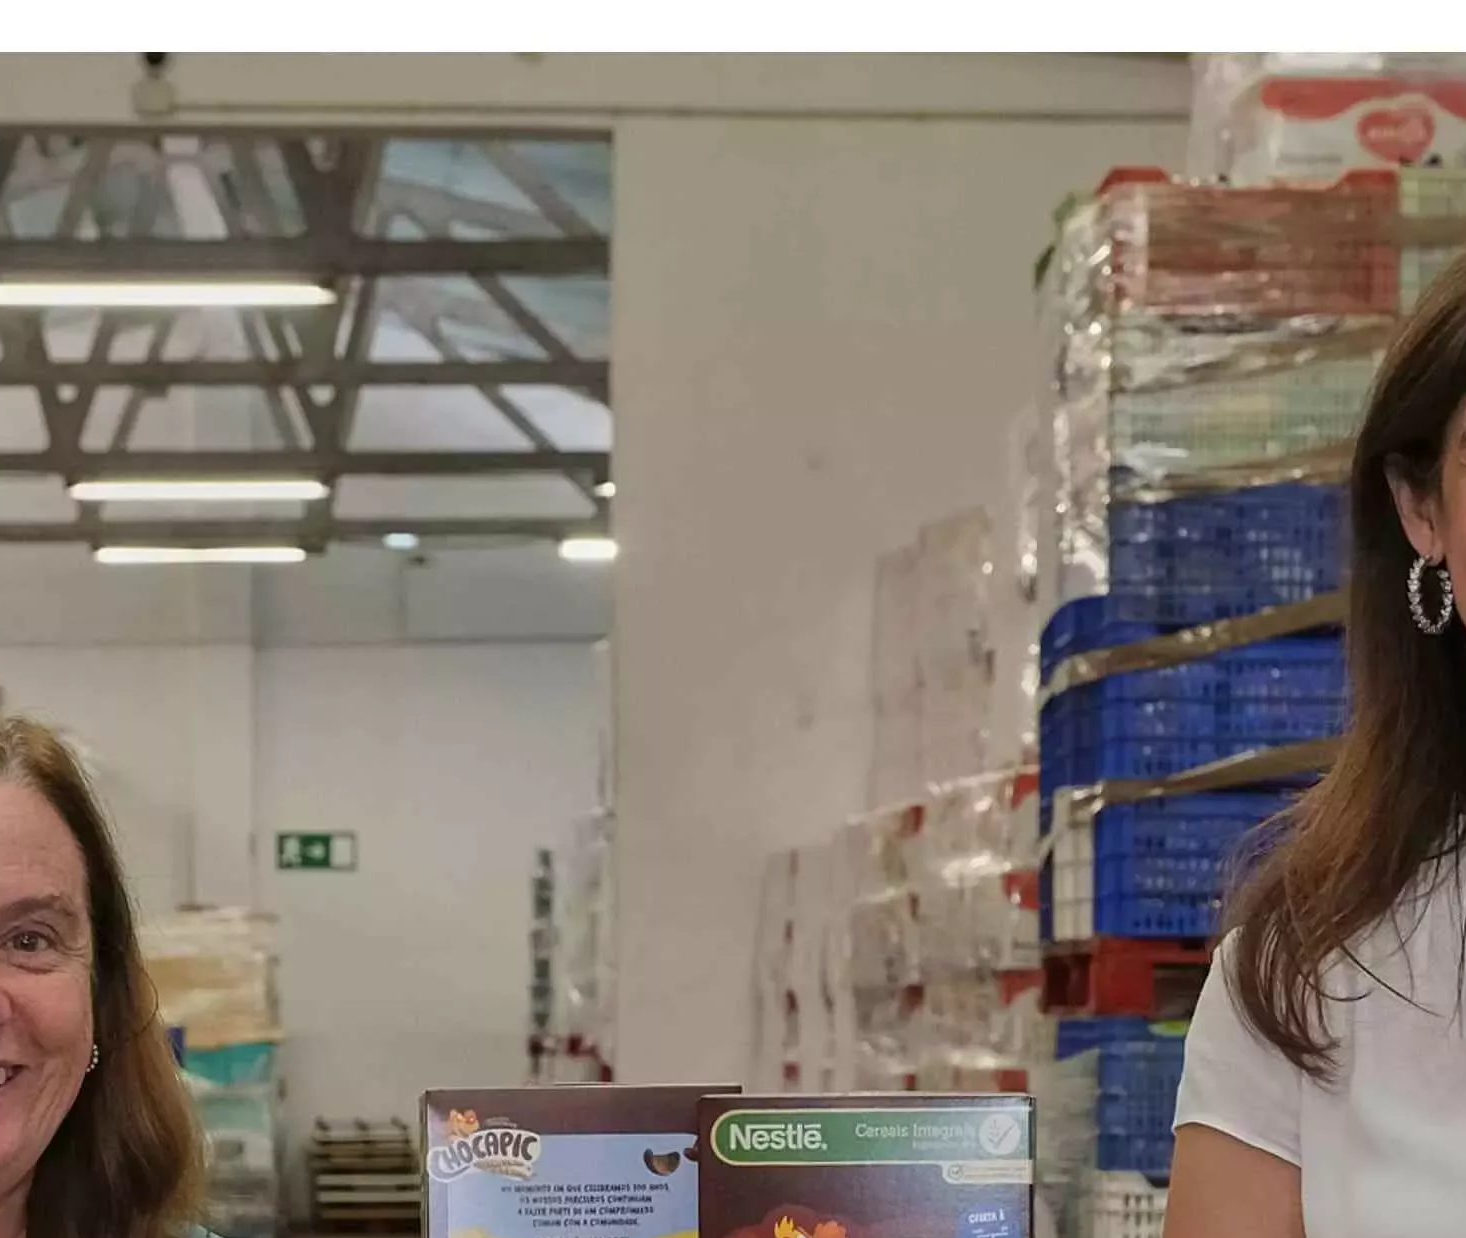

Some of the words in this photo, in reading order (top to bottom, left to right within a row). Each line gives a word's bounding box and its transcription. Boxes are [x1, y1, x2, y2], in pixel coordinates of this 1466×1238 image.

[729, 1123, 822, 1150] Nestlé
[856, 1123, 909, 1137] Cereais
[430, 1131, 538, 1179] CHOCAPIC
